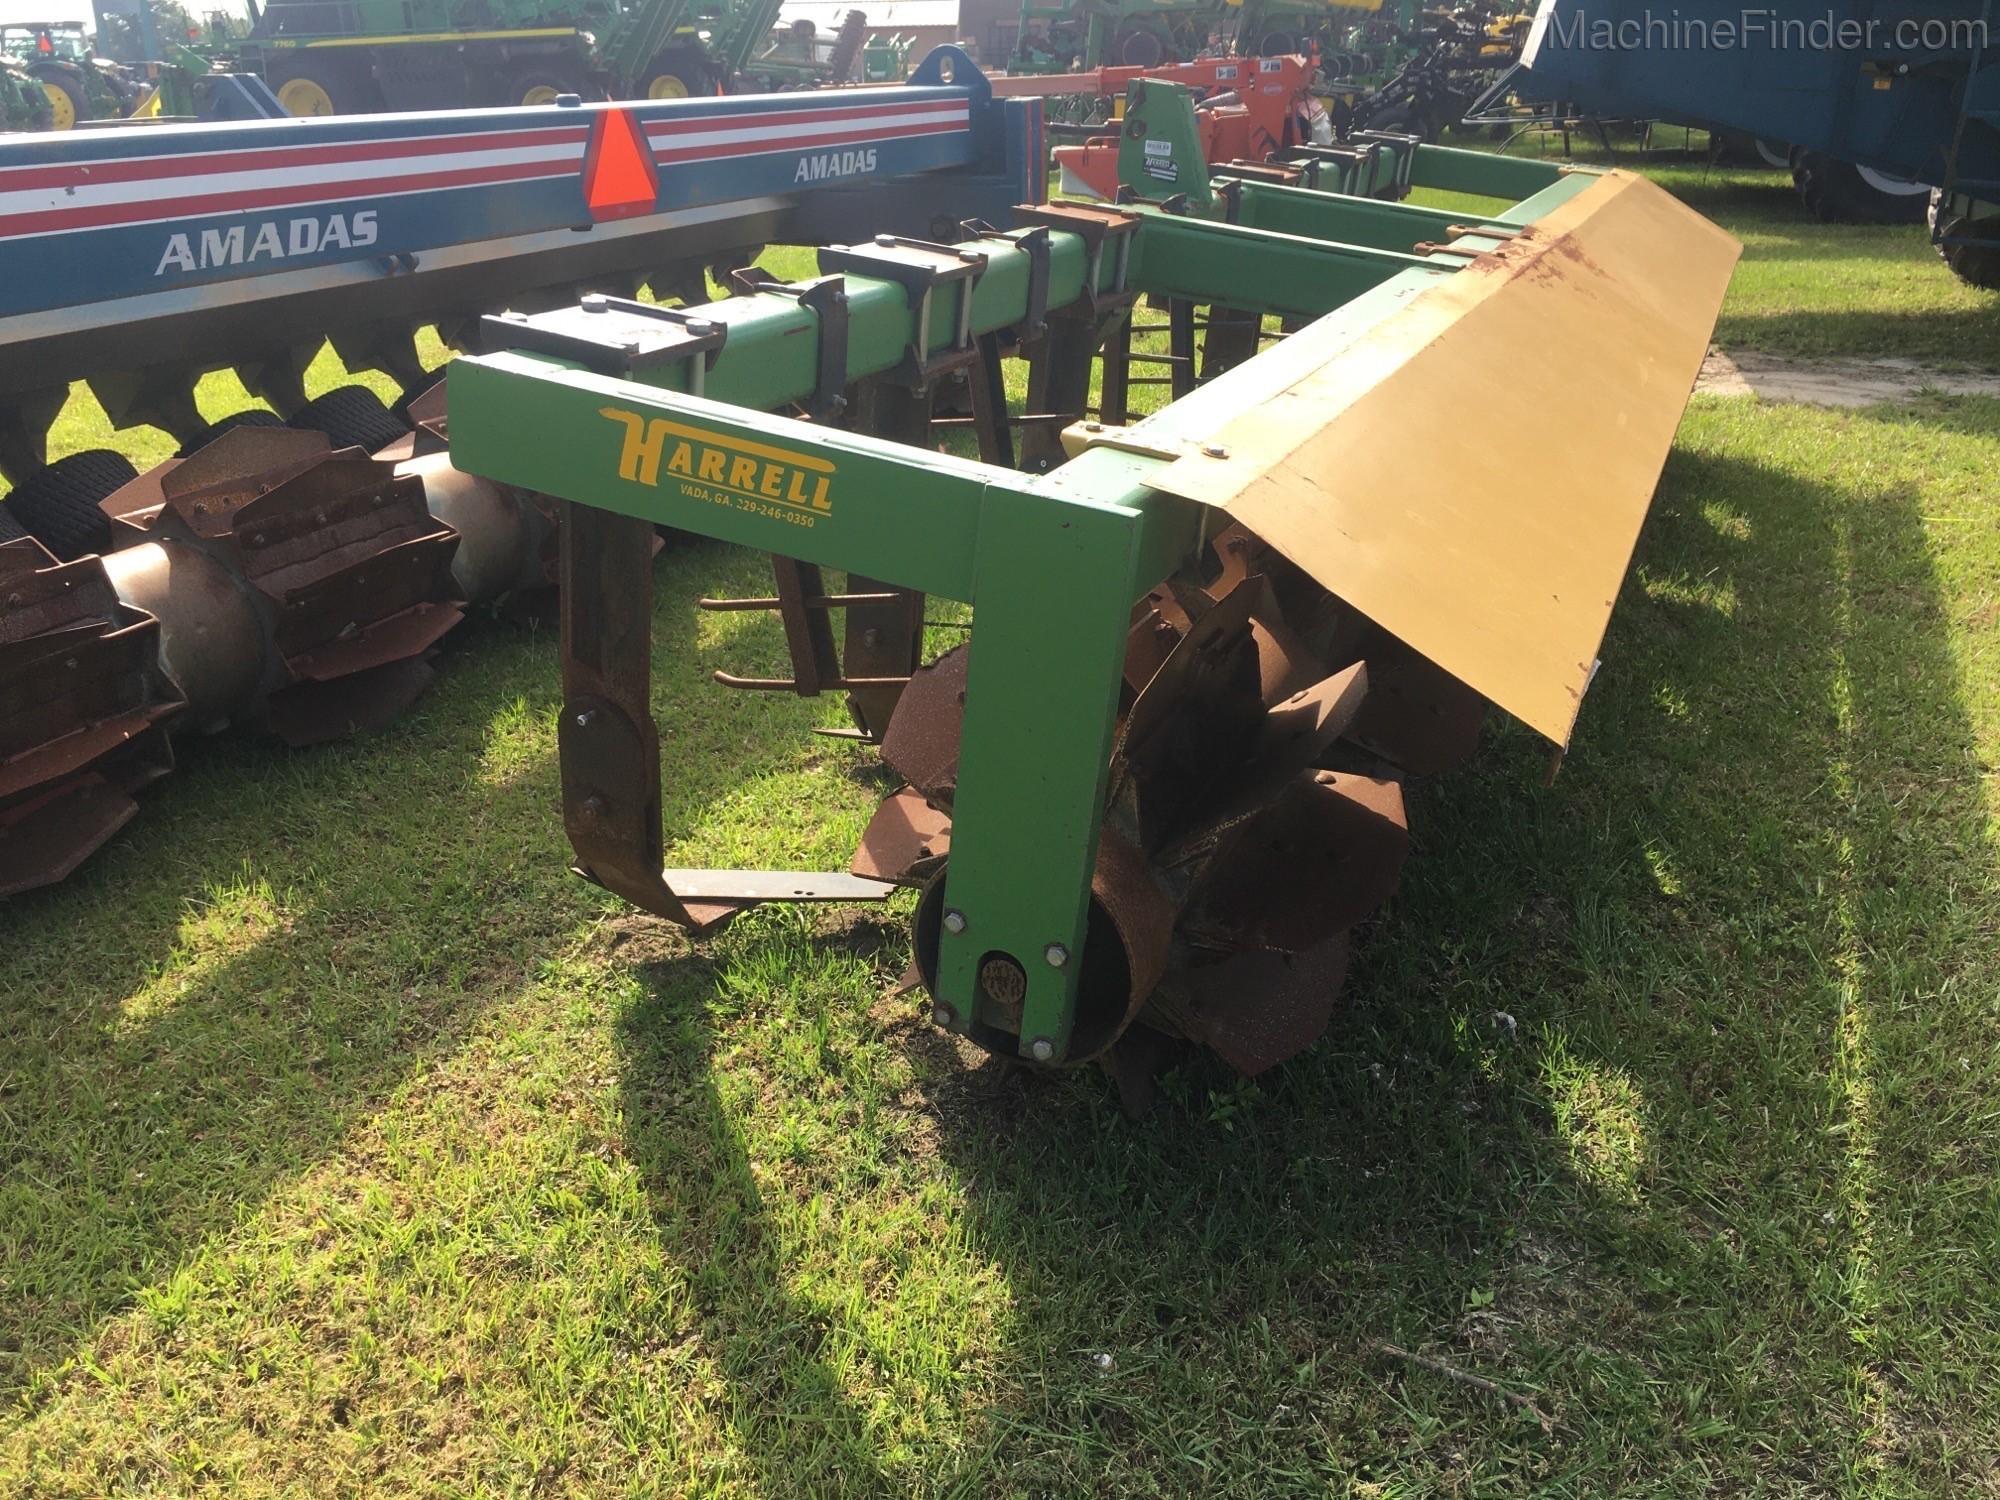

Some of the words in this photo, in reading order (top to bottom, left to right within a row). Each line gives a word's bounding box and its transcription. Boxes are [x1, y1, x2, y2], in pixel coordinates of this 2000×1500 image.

[273, 40, 296, 48] 7760
[793, 148, 877, 183] AMADAS
[154, 210, 378, 276] AMADAS
[599, 407, 836, 511] HARRELL
[681, 483, 712, 503] VADA,
[714, 493, 733, 507] GA.
[736, 498, 815, 528] 229-246-0350
